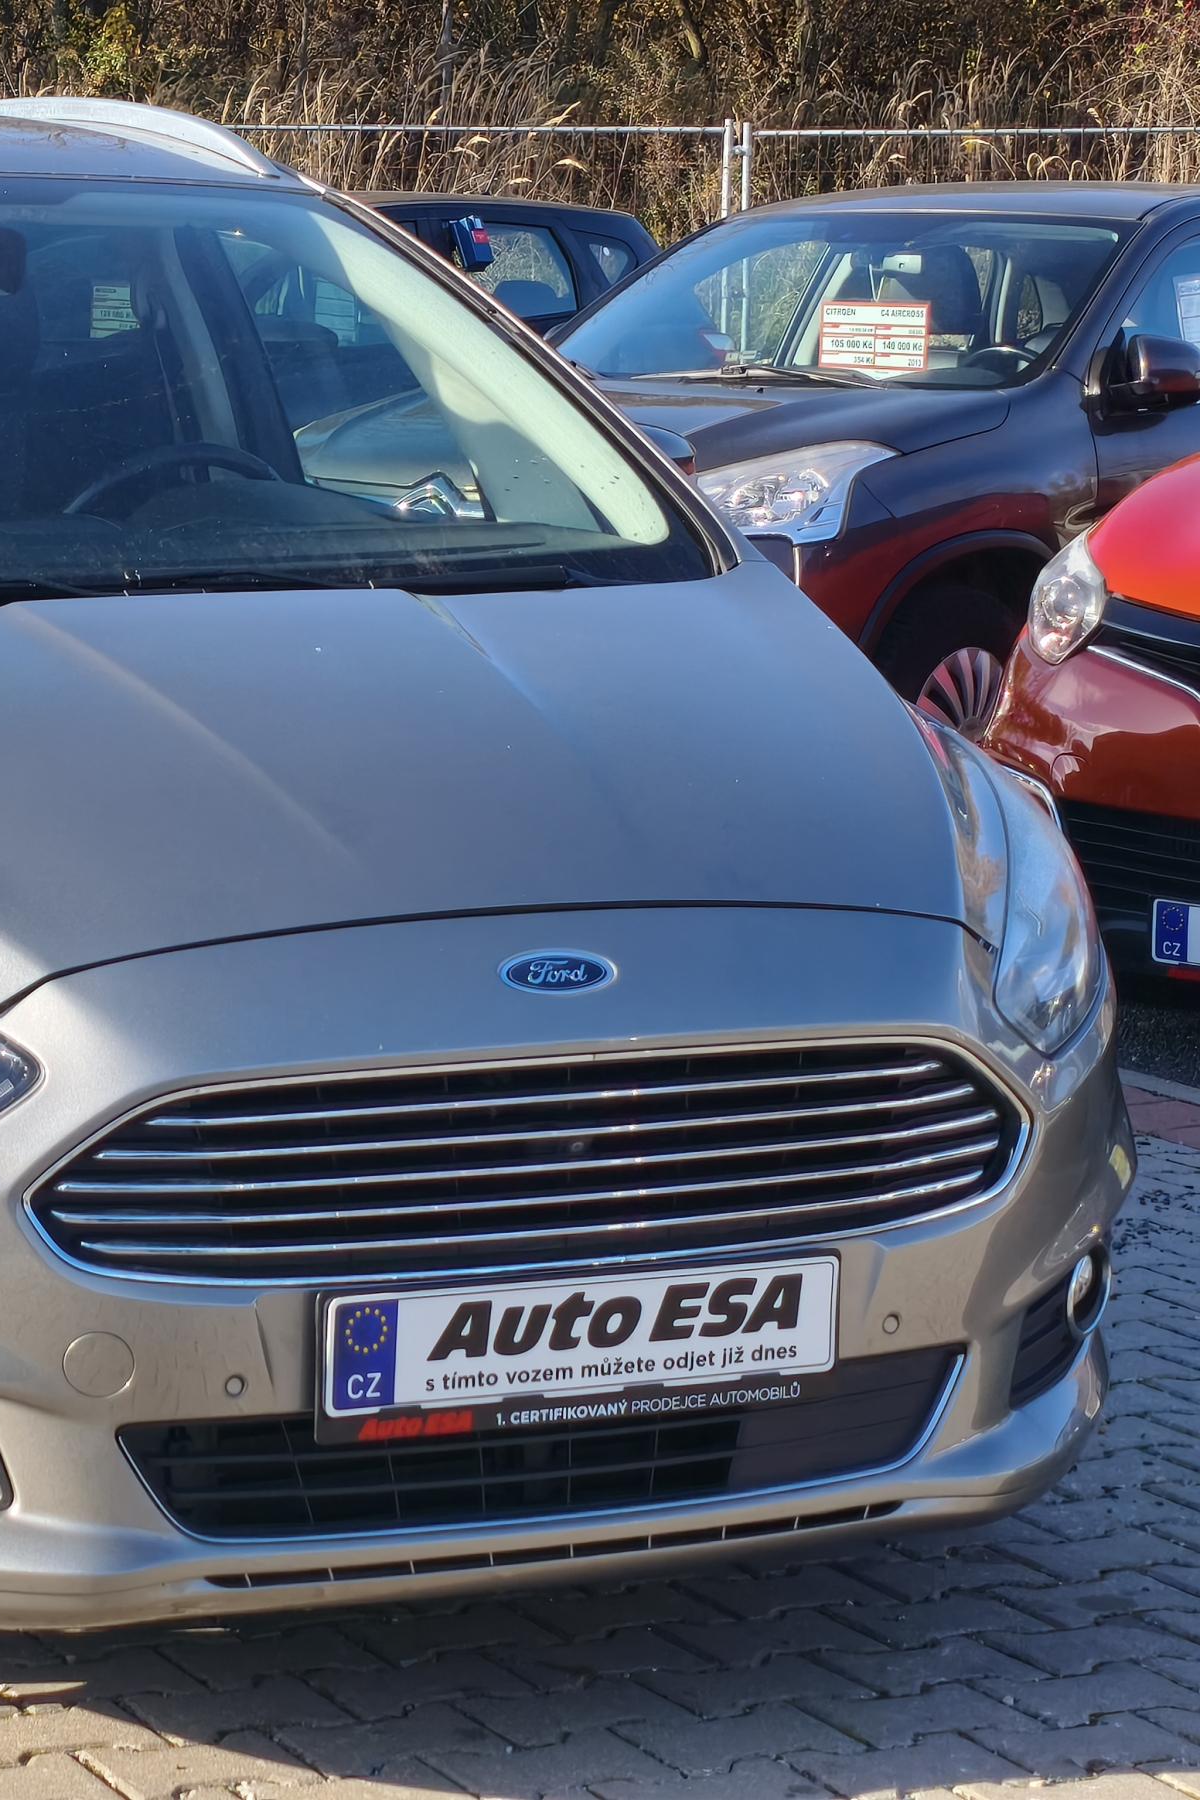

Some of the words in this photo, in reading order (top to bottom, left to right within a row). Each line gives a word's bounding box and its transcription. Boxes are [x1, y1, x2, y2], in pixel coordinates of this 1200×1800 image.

[880, 309, 890, 317] C4
[891, 309, 924, 318] AIRCROSS
[831, 339, 845, 348] 105
[846, 340, 861, 349] 000
[862, 340, 873, 349] Kč
[882, 341, 896, 350] 140
[897, 342, 911, 351] 000
[912, 342, 923, 352] Kč
[1162, 941, 1181, 957] CZ
[527, 960, 588, 985] Ford
[426, 1291, 642, 1361] Auto
[648, 1273, 803, 1342] ESA
[425, 1377, 435, 1392] s
[442, 1371, 499, 1391] tímto
[506, 1366, 574, 1385] vozem
[581, 1356, 656, 1378] můžete
[663, 1350, 716, 1372] odjet
[721, 1345, 745, 1369] již
[751, 1344, 798, 1362] dnes
[347, 1372, 382, 1400] CZ
[496, 1412, 506, 1426] 1.
[510, 1399, 628, 1425] CERTIFIKOVANÝ
[631, 1393, 707, 1414] PRODEJCE
[710, 1381, 800, 1406] AUTOMOBILŮ
[358, 1415, 424, 1441] Auto
[424, 1410, 474, 1436] ESA
